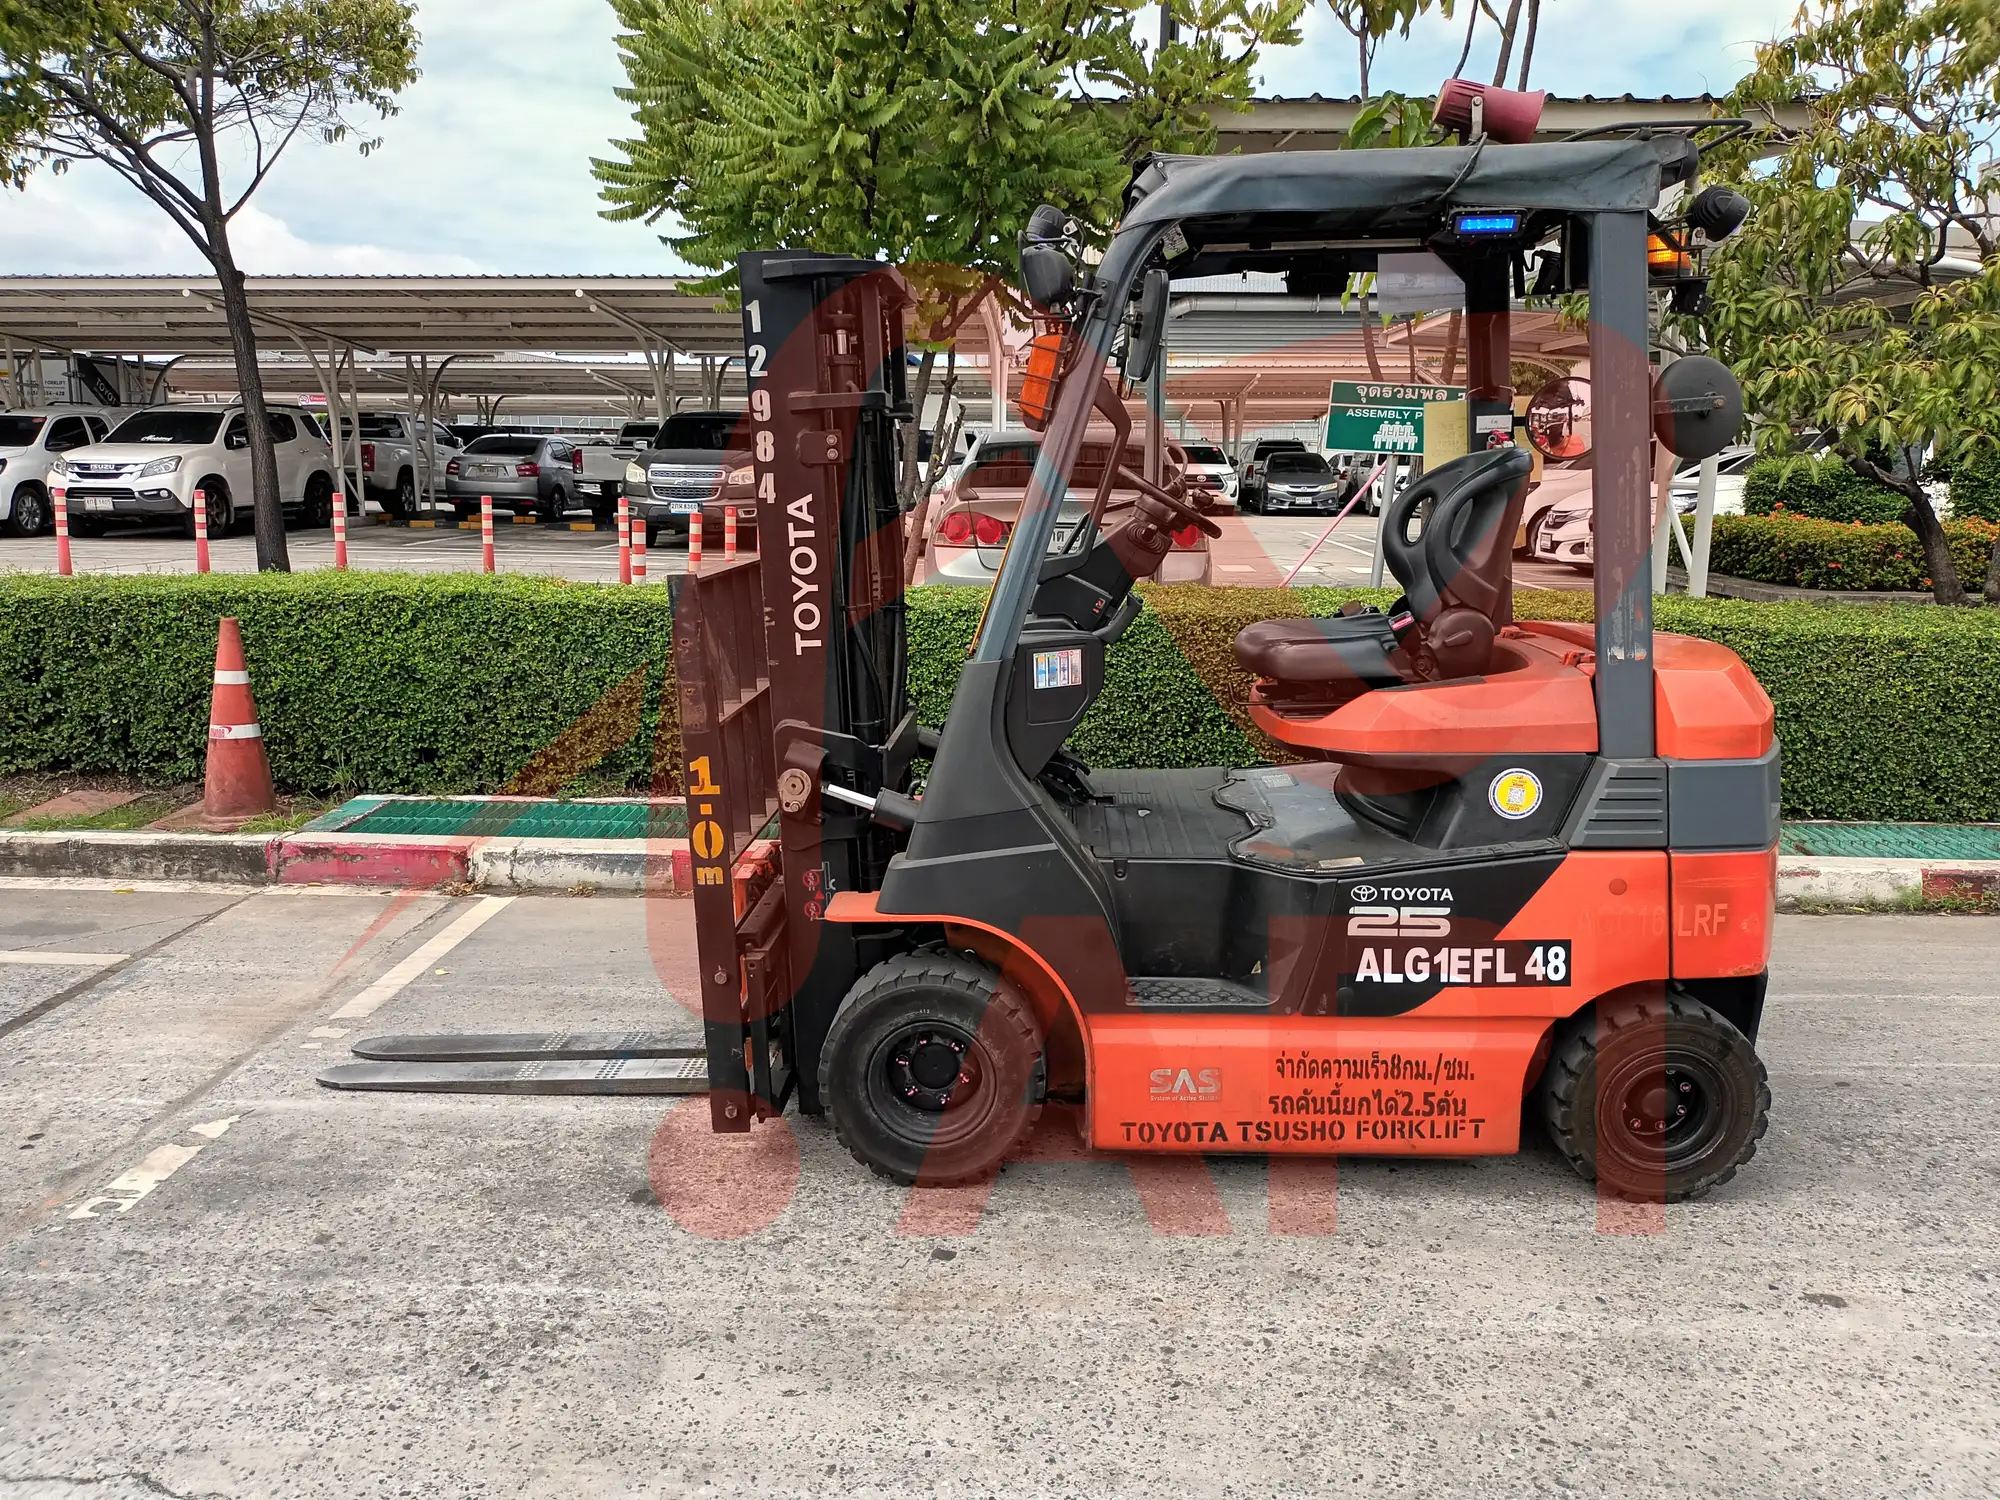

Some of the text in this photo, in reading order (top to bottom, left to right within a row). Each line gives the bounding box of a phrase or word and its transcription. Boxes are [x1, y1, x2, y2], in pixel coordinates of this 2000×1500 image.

[96, 378, 117, 406] TOYOT
[1356, 385, 1448, 404] จุดรวมพล
[1346, 408, 1411, 420] ASSEMBLY
[786, 492, 823, 656] TOYOTA
[1380, 887, 1454, 902] TOYOTA
[1347, 906, 1452, 938] 25
[1677, 903, 1729, 937] LRF
[1355, 945, 1567, 984] ALG1EFL 48
[1149, 1068, 1222, 1094] SAS
[1119, 1118, 1486, 1144] TOYOTA TSUSHO FORKLIFT
